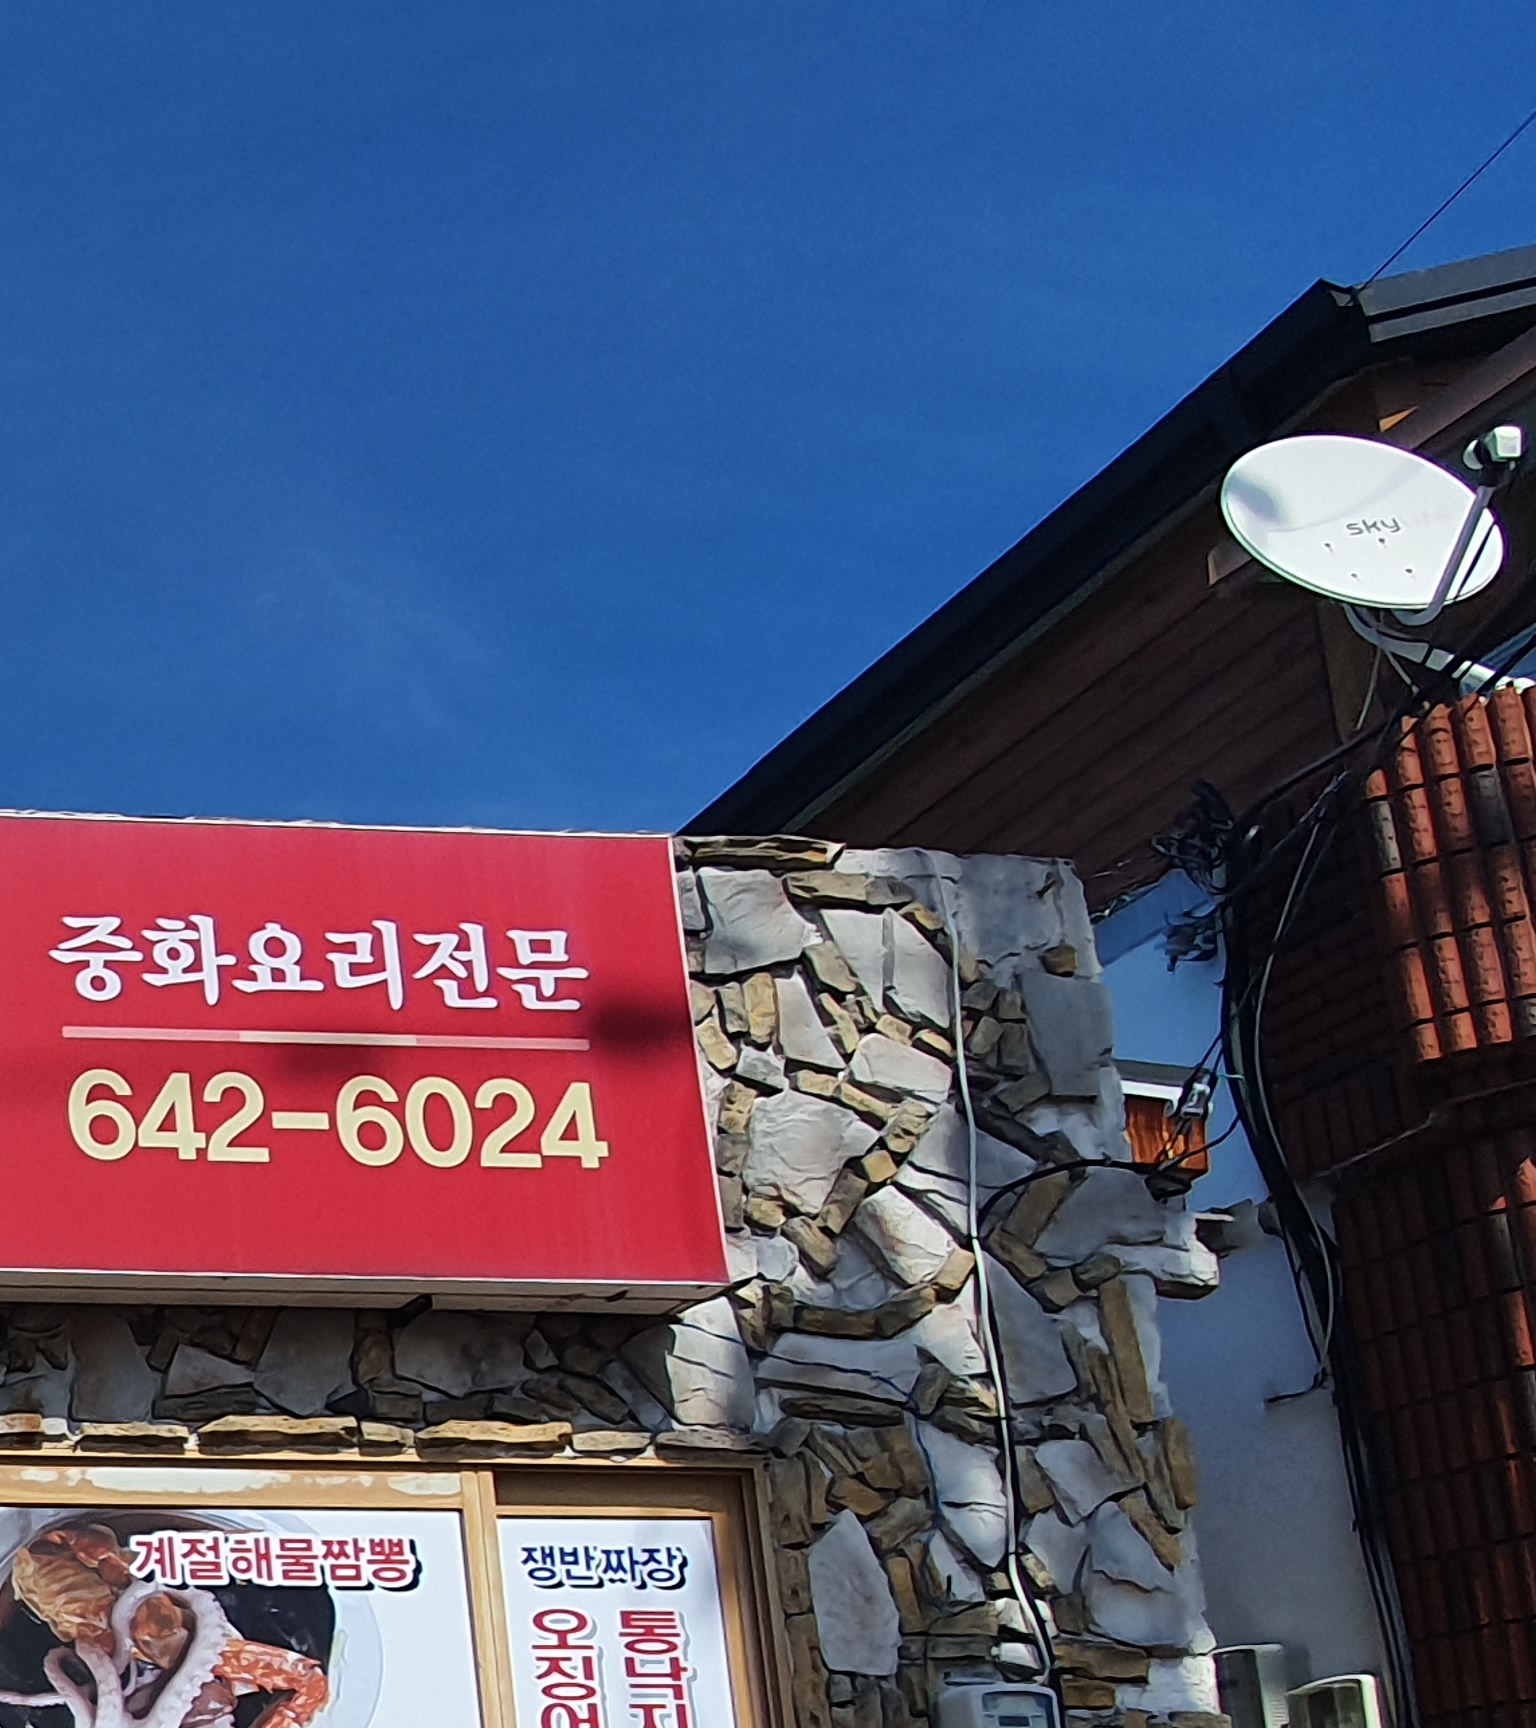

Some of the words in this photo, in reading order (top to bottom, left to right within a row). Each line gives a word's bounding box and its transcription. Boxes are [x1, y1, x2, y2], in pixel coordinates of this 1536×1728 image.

[47, 913, 590, 1012] 중화요리전문
[66, 1067, 610, 1170] 642-6024
[519, 1544, 682, 1584] 쟁반짜장
